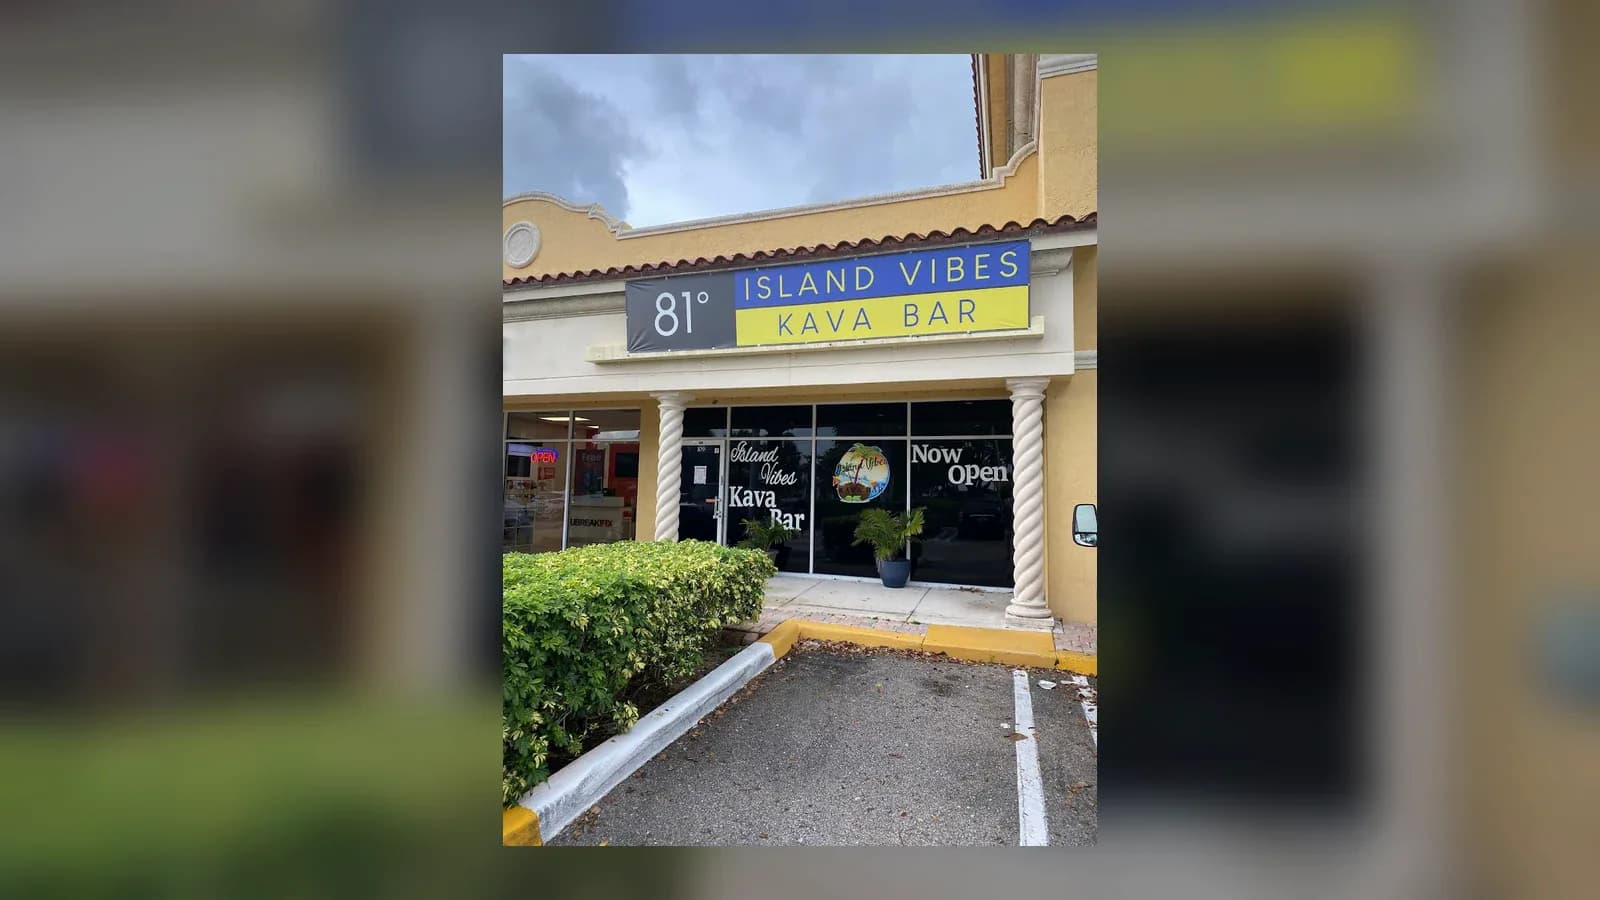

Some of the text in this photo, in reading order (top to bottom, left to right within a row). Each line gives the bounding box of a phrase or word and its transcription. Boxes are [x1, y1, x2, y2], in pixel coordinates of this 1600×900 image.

[744, 250, 1019, 301] ISLAND VIBES
[778, 299, 977, 337] KAVA BAR
[530, 451, 556, 464] OPEN
[730, 440, 779, 463] Island
[911, 444, 963, 464] Now
[761, 462, 798, 486] Vibes
[947, 463, 1009, 486] Open
[728, 486, 777, 508] Kava
[768, 508, 805, 531] Bar
